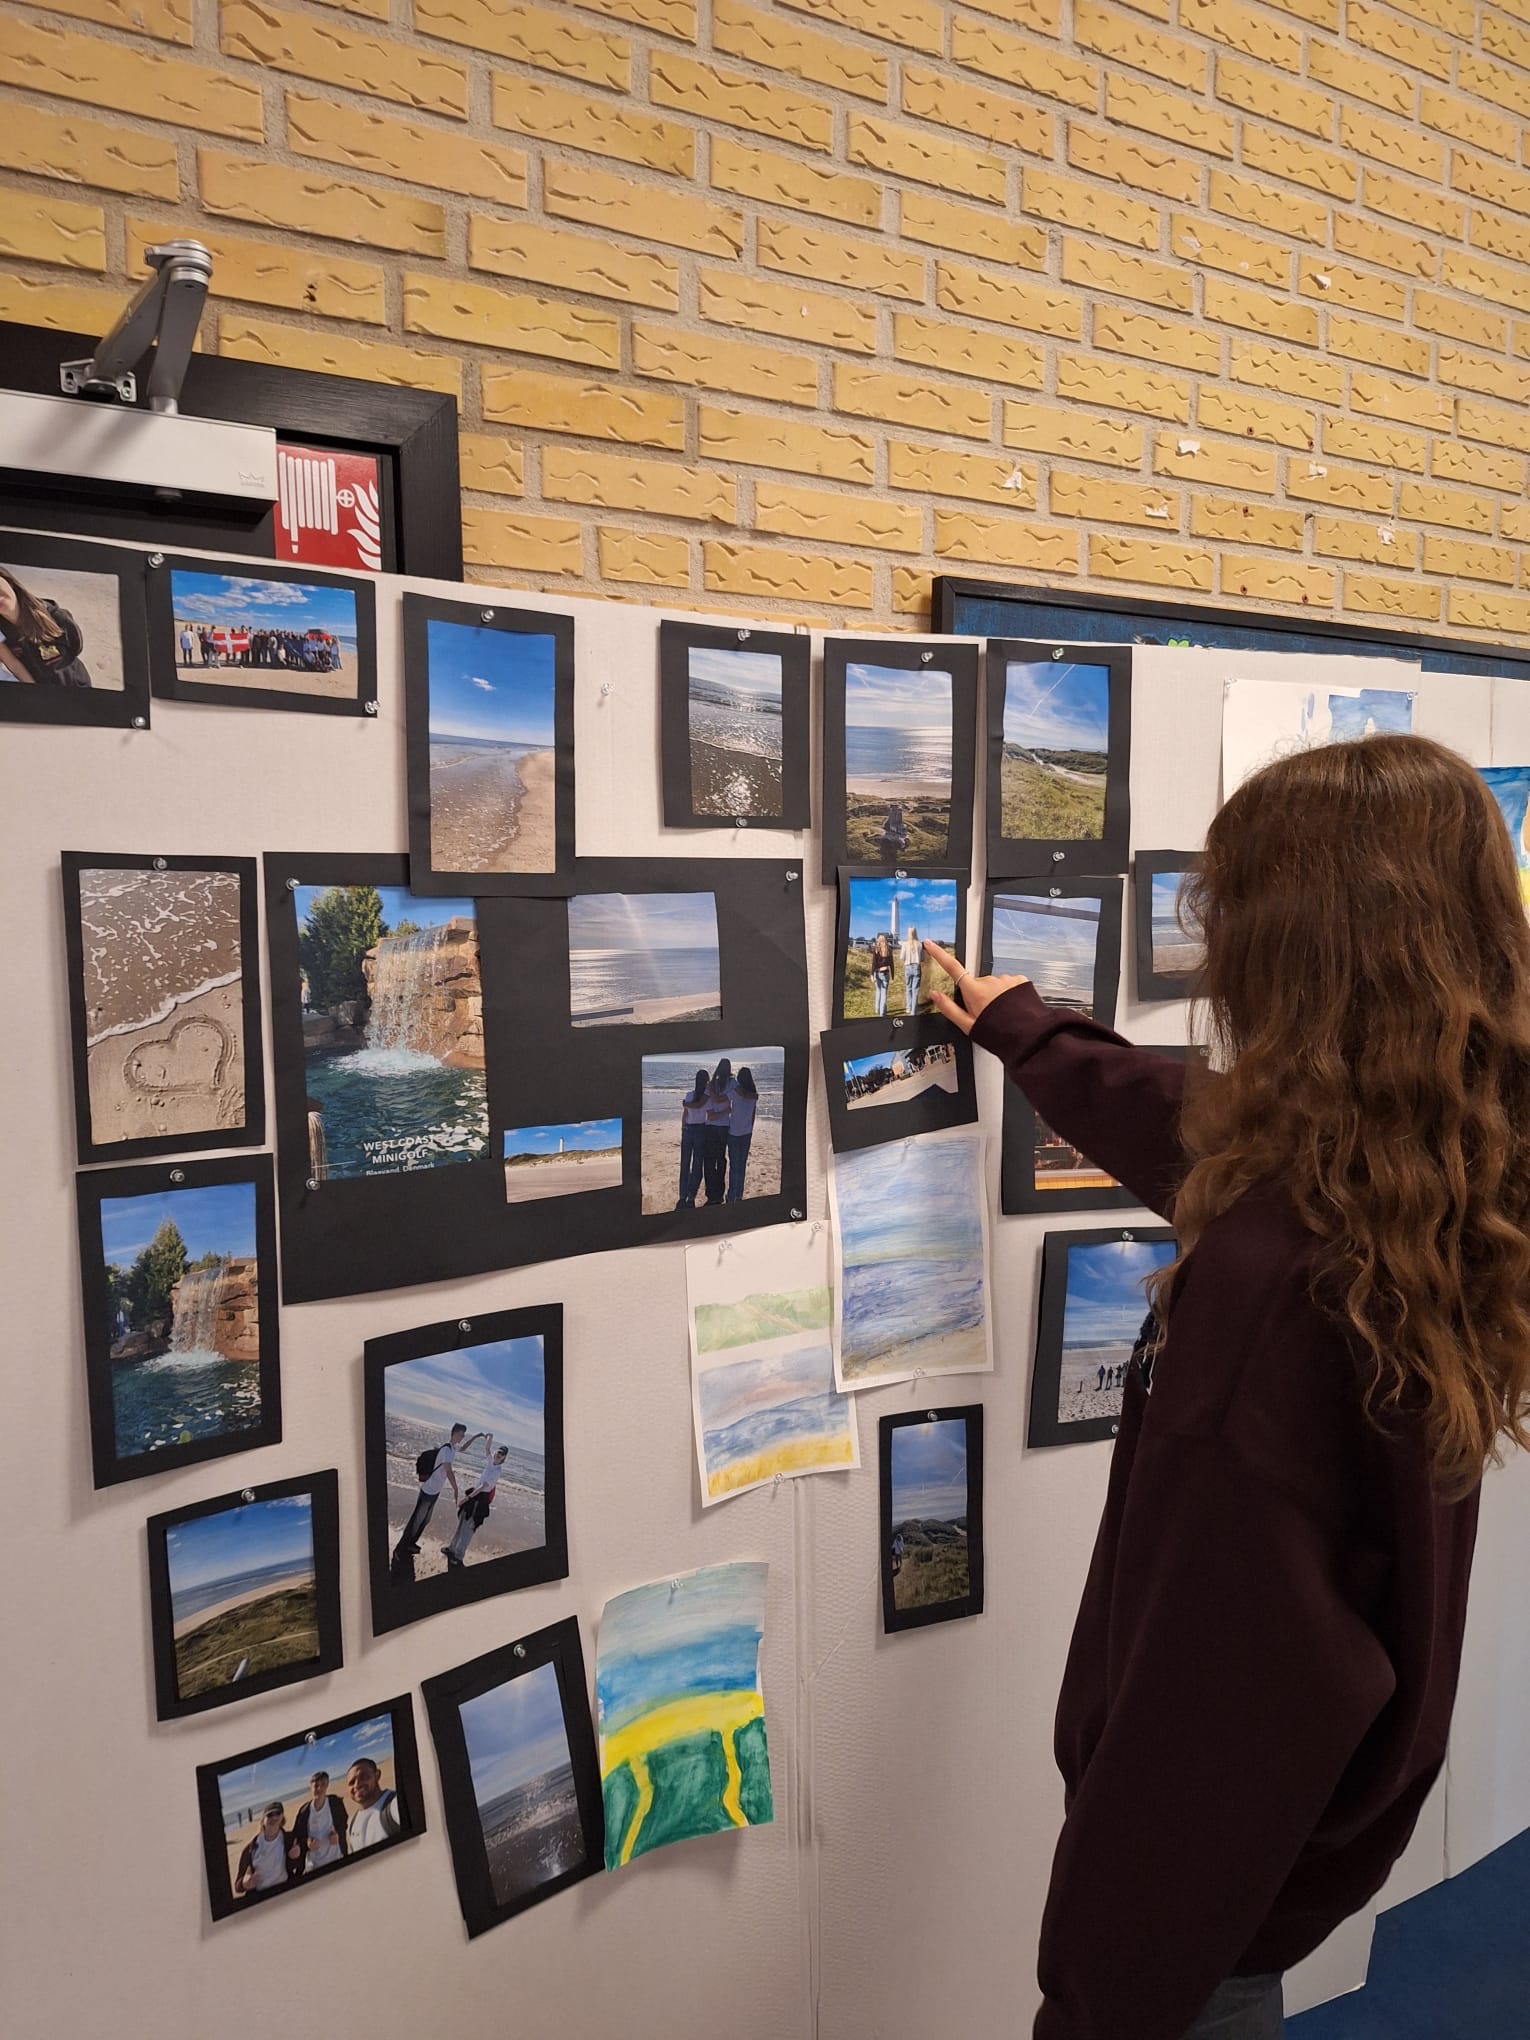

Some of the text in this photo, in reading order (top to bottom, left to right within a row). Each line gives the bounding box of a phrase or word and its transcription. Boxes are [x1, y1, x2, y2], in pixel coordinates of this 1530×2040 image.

[363, 1134, 434, 1152] WEST COAST
[372, 1149, 428, 1164] MINIGOLF
[402, 1162, 435, 1172] Denmark
